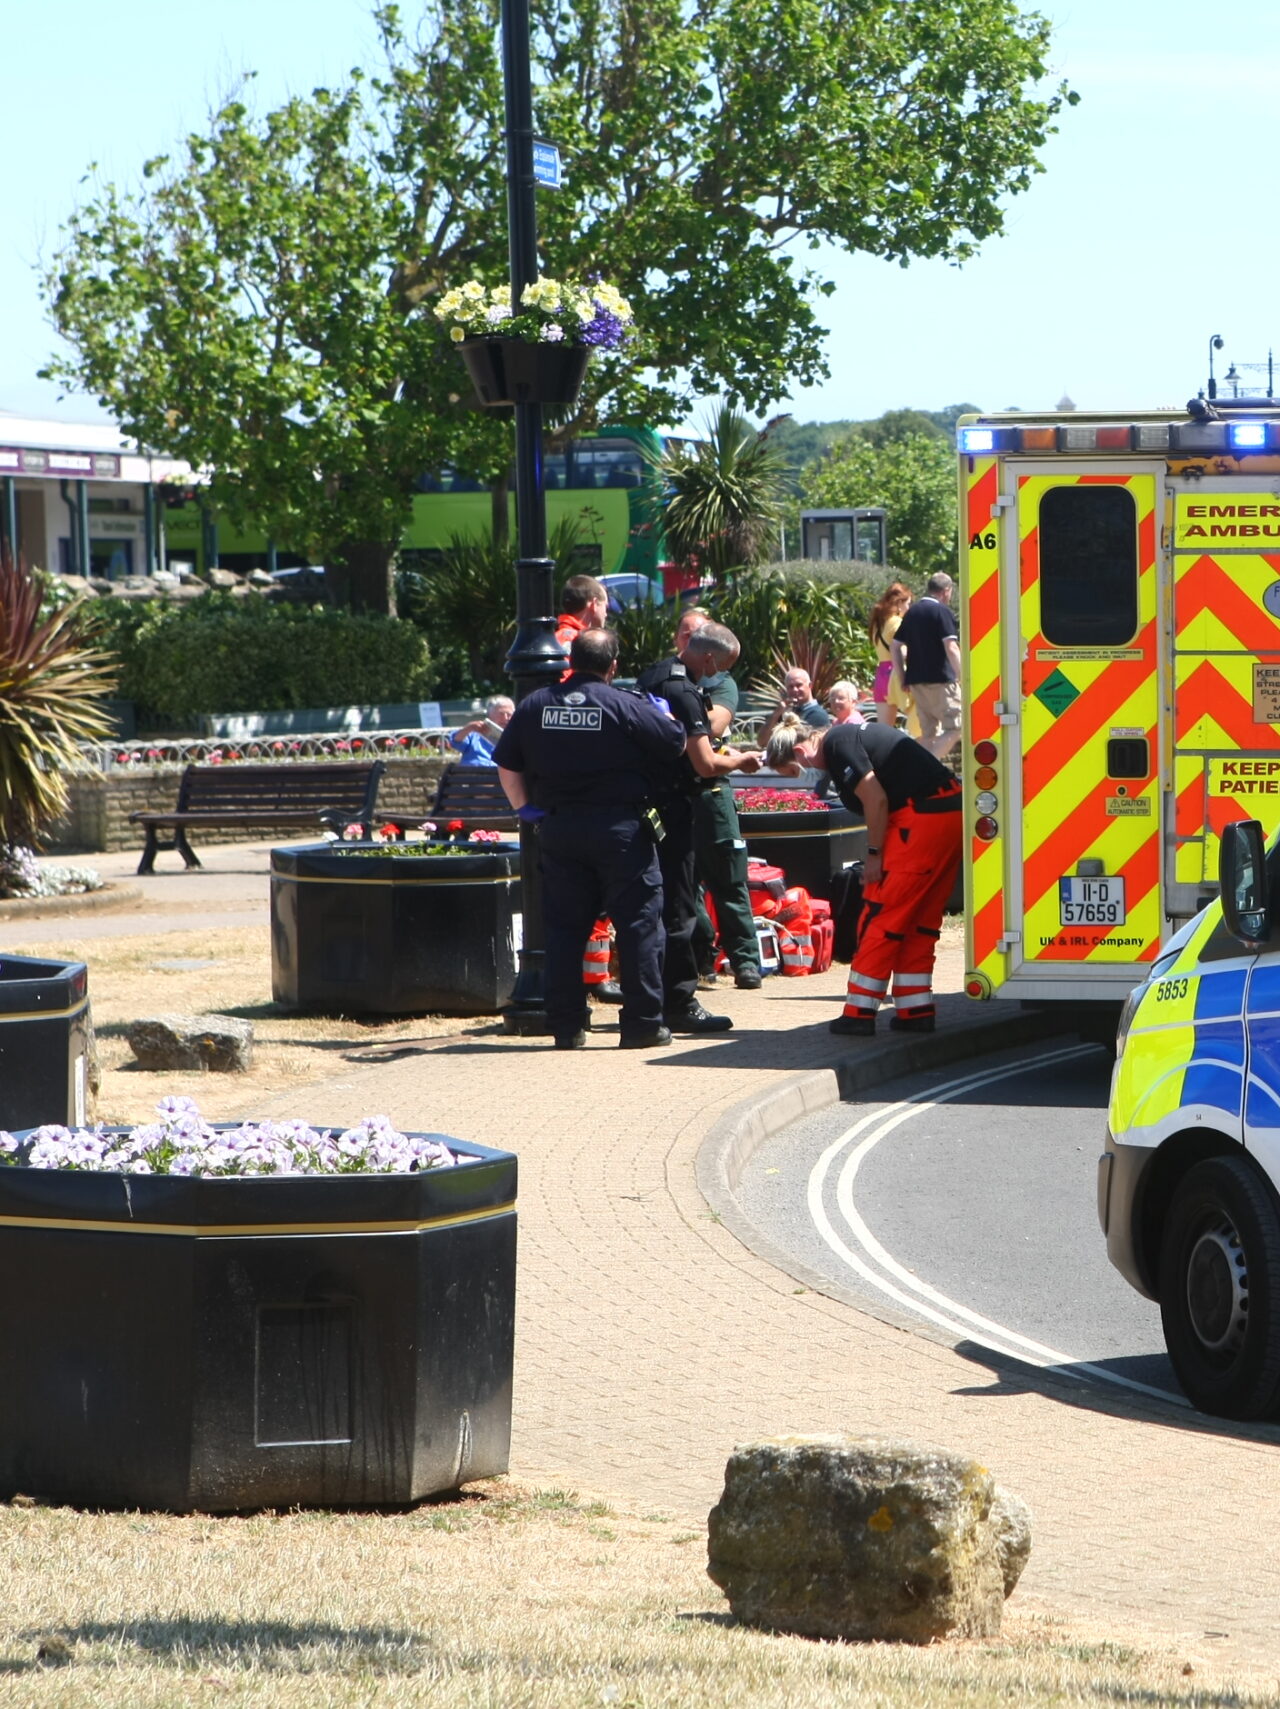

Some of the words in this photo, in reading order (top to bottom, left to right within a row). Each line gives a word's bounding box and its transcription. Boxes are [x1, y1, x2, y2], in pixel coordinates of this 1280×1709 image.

[970, 533, 997, 550] A6
[545, 710, 599, 726] MEDIC
[1222, 762, 1280, 775] KEEP
[1120, 799, 1147, 807] CAUTION
[1064, 903, 1117, 922] 57659
[1040, 937, 1056, 946] UK
[1058, 937, 1067, 946] &
[1070, 936, 1089, 946] IRL
[1091, 937, 1145, 947] Company
[1156, 978, 1189, 1002] 5853
